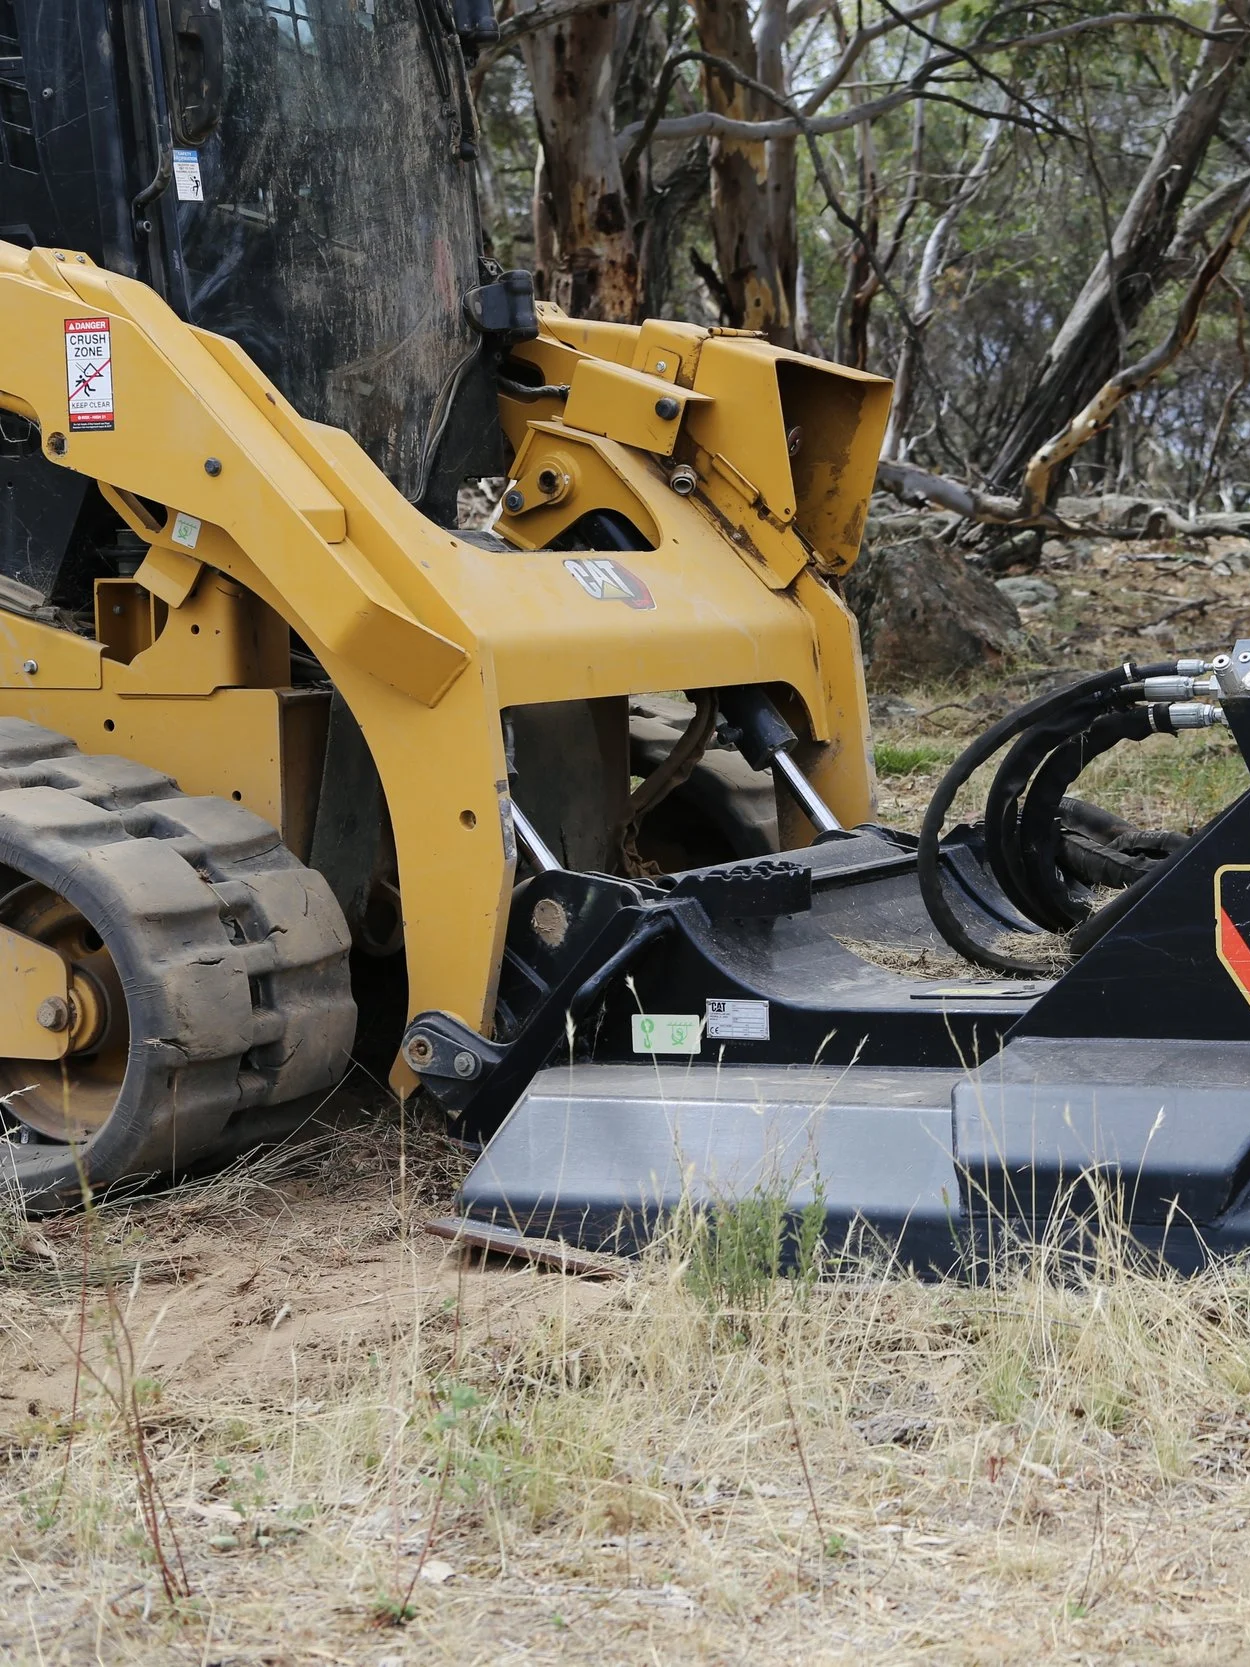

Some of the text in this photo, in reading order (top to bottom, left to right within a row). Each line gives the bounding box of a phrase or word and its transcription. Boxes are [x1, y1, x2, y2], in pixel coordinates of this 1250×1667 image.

[75, 321, 106, 330] DANGER
[70, 334, 106, 345] CRUSH
[74, 346, 103, 357] ZONE
[89, 401, 111, 409] CLEAR
[563, 559, 635, 599] CAT
[712, 1002, 726, 1012] CAT
